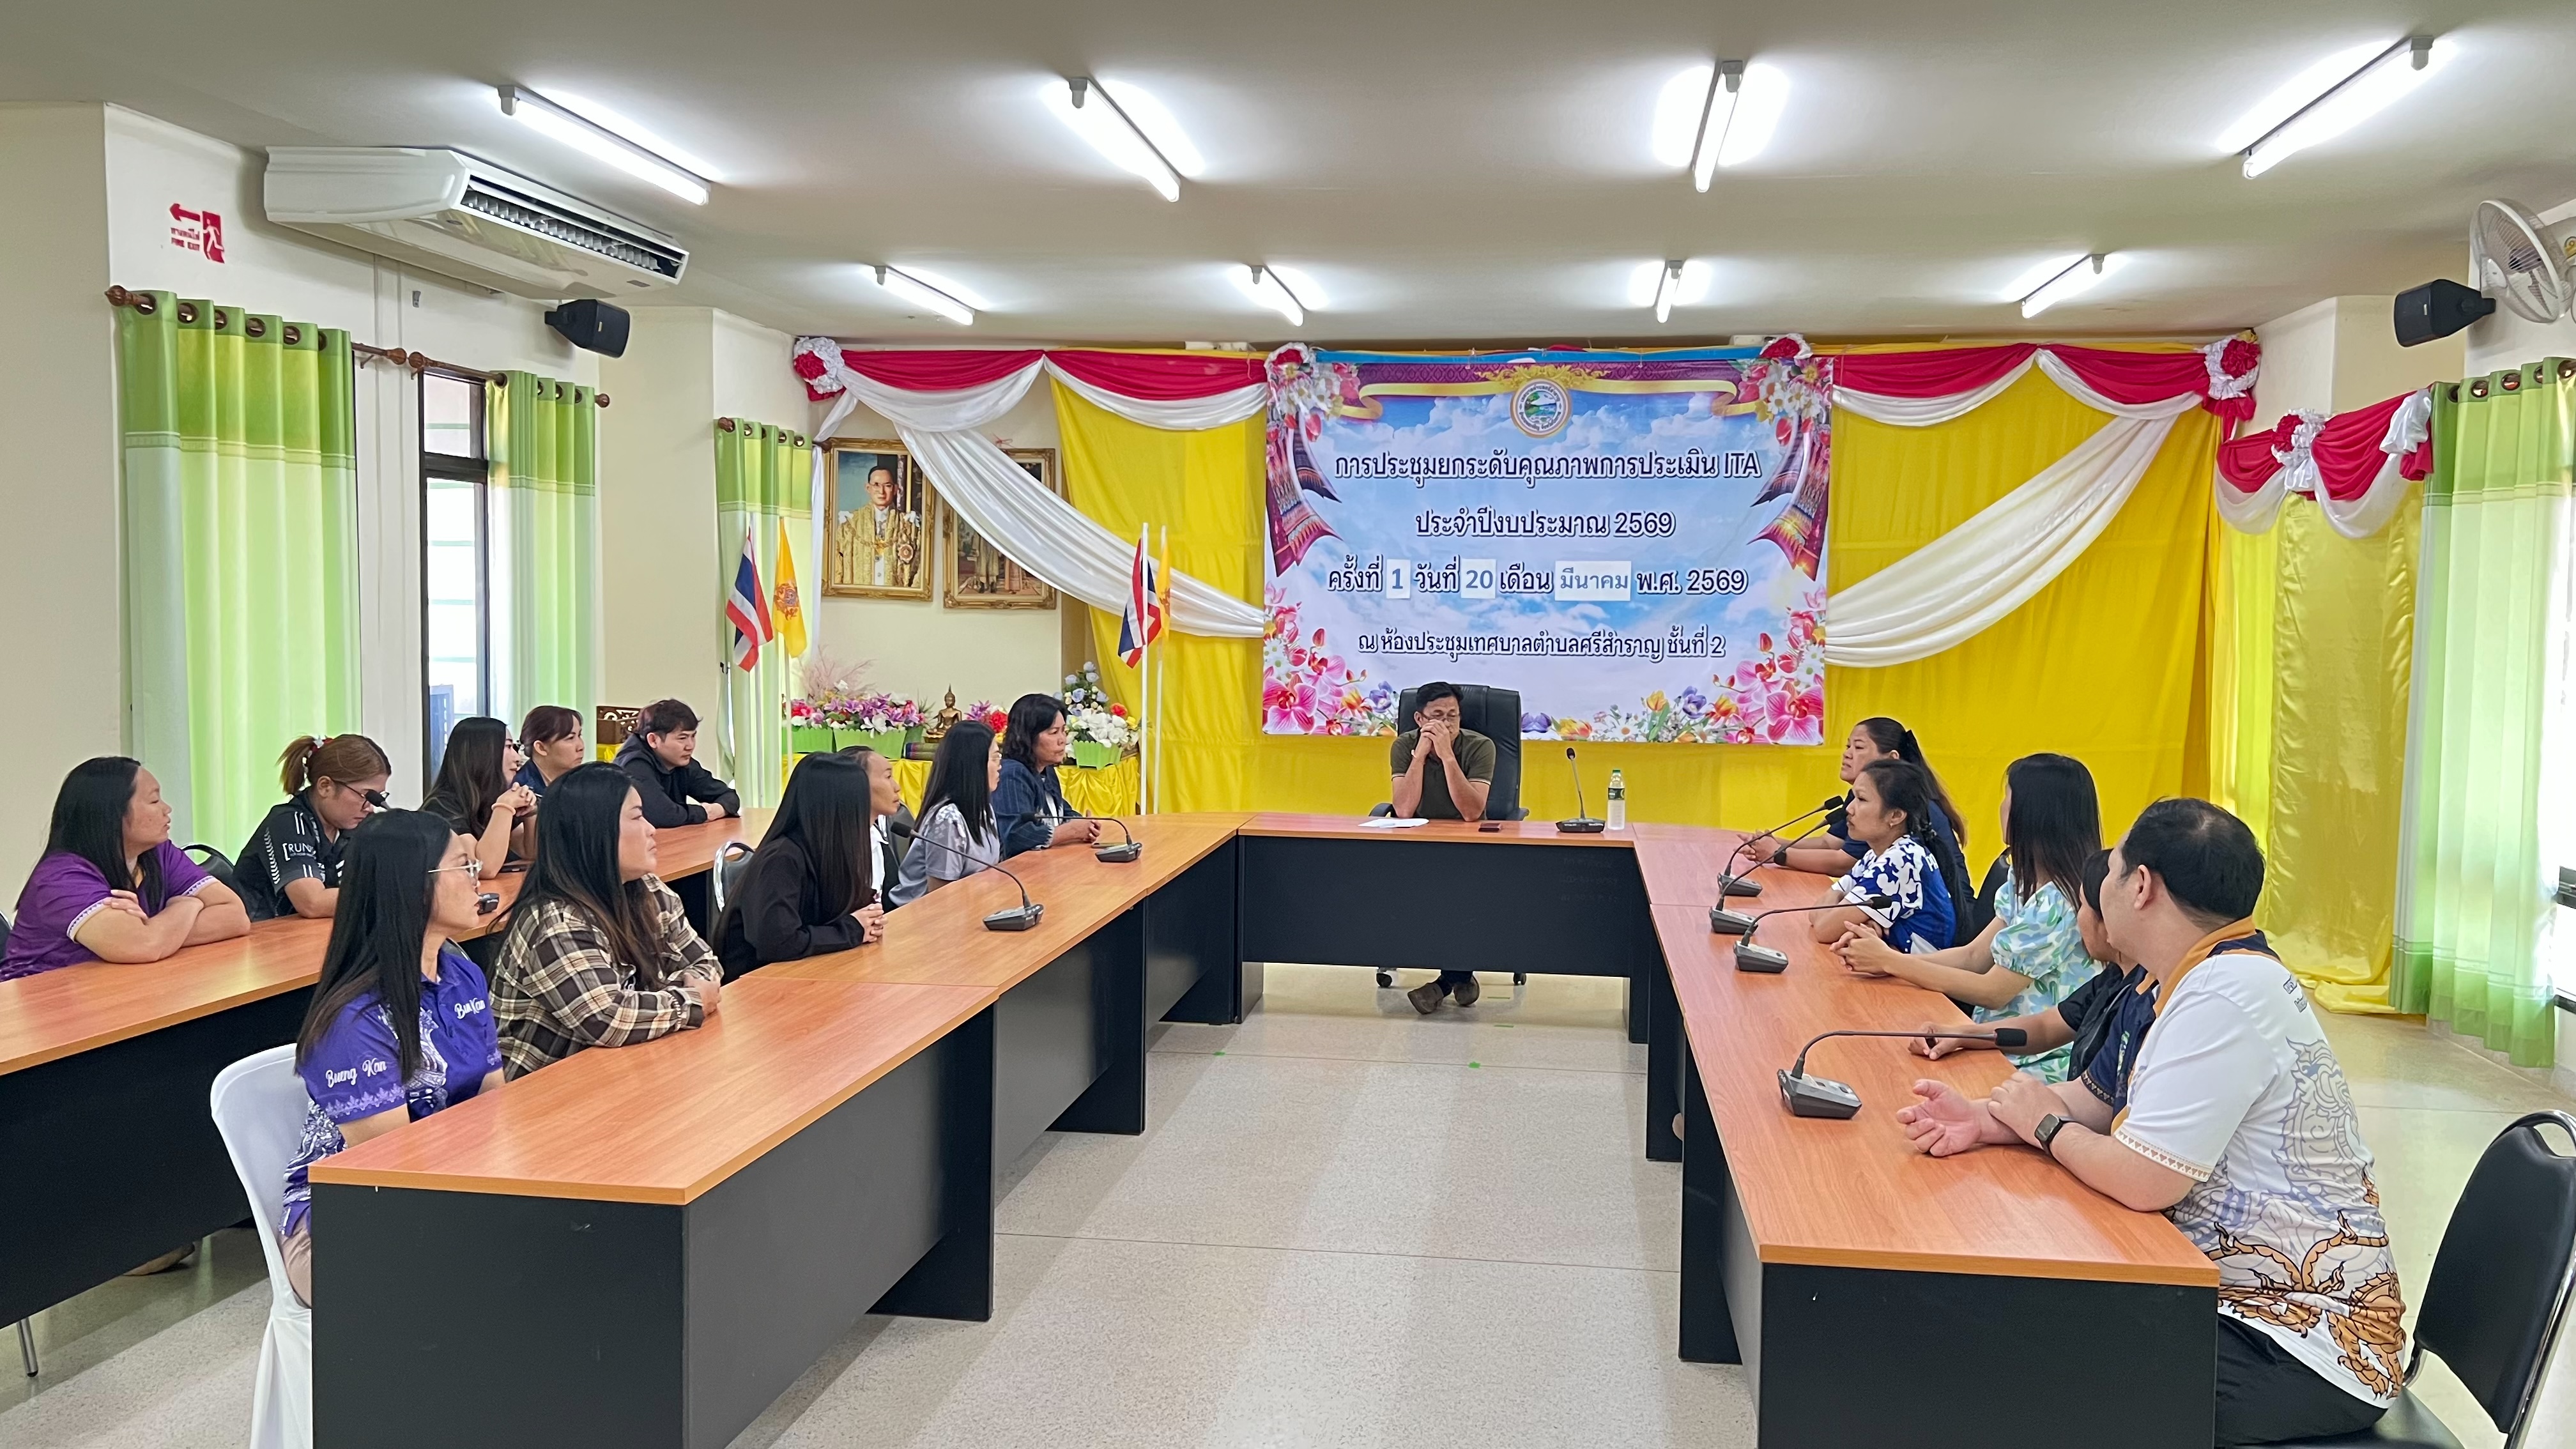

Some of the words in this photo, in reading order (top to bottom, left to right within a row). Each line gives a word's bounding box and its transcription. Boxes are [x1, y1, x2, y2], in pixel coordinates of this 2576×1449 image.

[1335, 448, 1717, 485] การประชุมยกระดับคุณภาพการประเมิน
[1724, 452, 1759, 475] ITA
[1415, 506, 1607, 534] ประจำปีงบประมาณ
[1614, 512, 1674, 534] 2569
[1328, 554, 1381, 589] ครั้งที่
[1392, 567, 1404, 590] 1
[1416, 556, 1457, 589] วันที่
[1465, 569, 1494, 590] 20
[1500, 562, 1551, 590] เดือน
[1560, 567, 1629, 590] มีนาคม
[1636, 571, 1680, 592] พ.ศ.
[1687, 569, 1745, 592] 2569
[1381, 627, 1662, 660] ห้องประชุมเทศบาลตำบลศรีสำราญ
[1667, 625, 1705, 654] ชั้นที่
[1711, 636, 1723, 654] 2
[325, 1069, 358, 1088] Bueng
[362, 1057, 387, 1077] Kan
